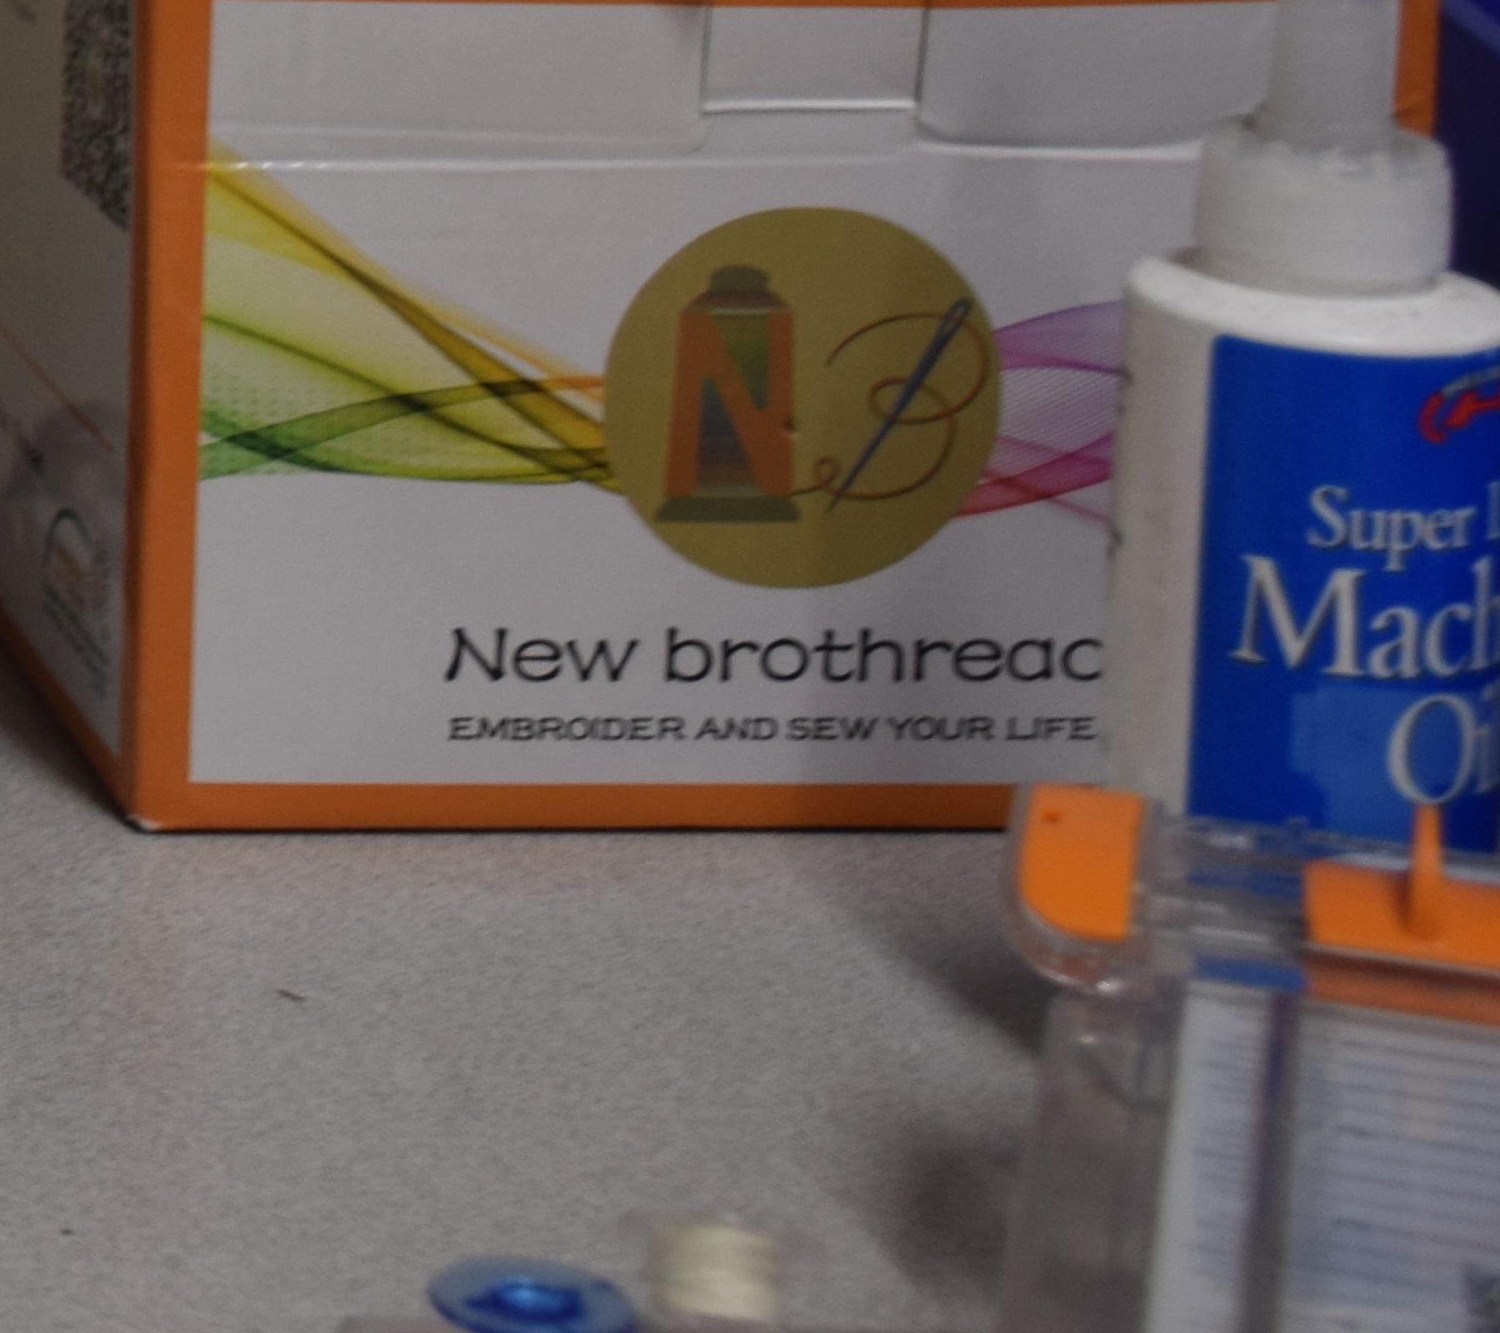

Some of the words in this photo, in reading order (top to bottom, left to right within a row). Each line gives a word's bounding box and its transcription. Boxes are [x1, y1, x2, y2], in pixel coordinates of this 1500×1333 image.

[1306, 483, 1476, 573] Super
[443, 626, 641, 683] New
[446, 716, 686, 744] EMBROIDER
[699, 715, 779, 743] AND
[787, 715, 876, 742] SEW
[884, 714, 997, 742] YOUR
[1005, 714, 1097, 742] LIFE
